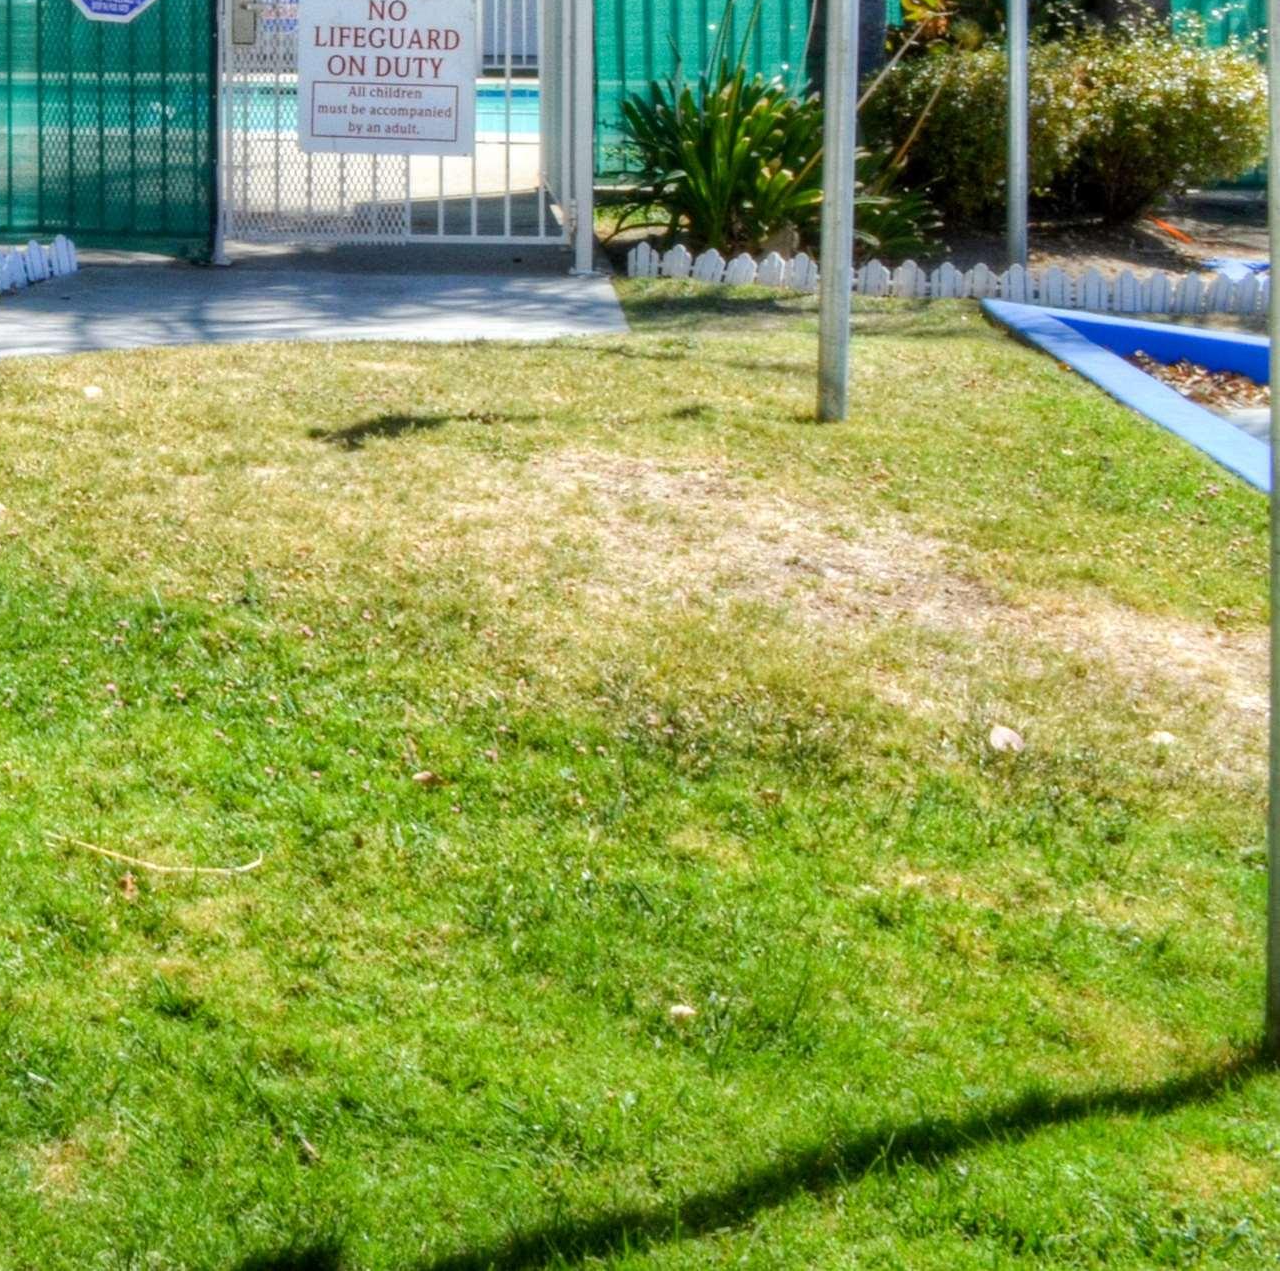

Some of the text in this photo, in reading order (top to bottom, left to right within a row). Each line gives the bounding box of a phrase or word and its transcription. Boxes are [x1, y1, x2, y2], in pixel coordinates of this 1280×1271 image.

[368, 0, 407, 22] NO
[314, 25, 460, 51] LIFEGUARD
[327, 54, 444, 79] ON DUTY
[347, 86, 423, 99] All children
[317, 104, 453, 119] must be accompanied
[347, 121, 421, 136] by an adult.
